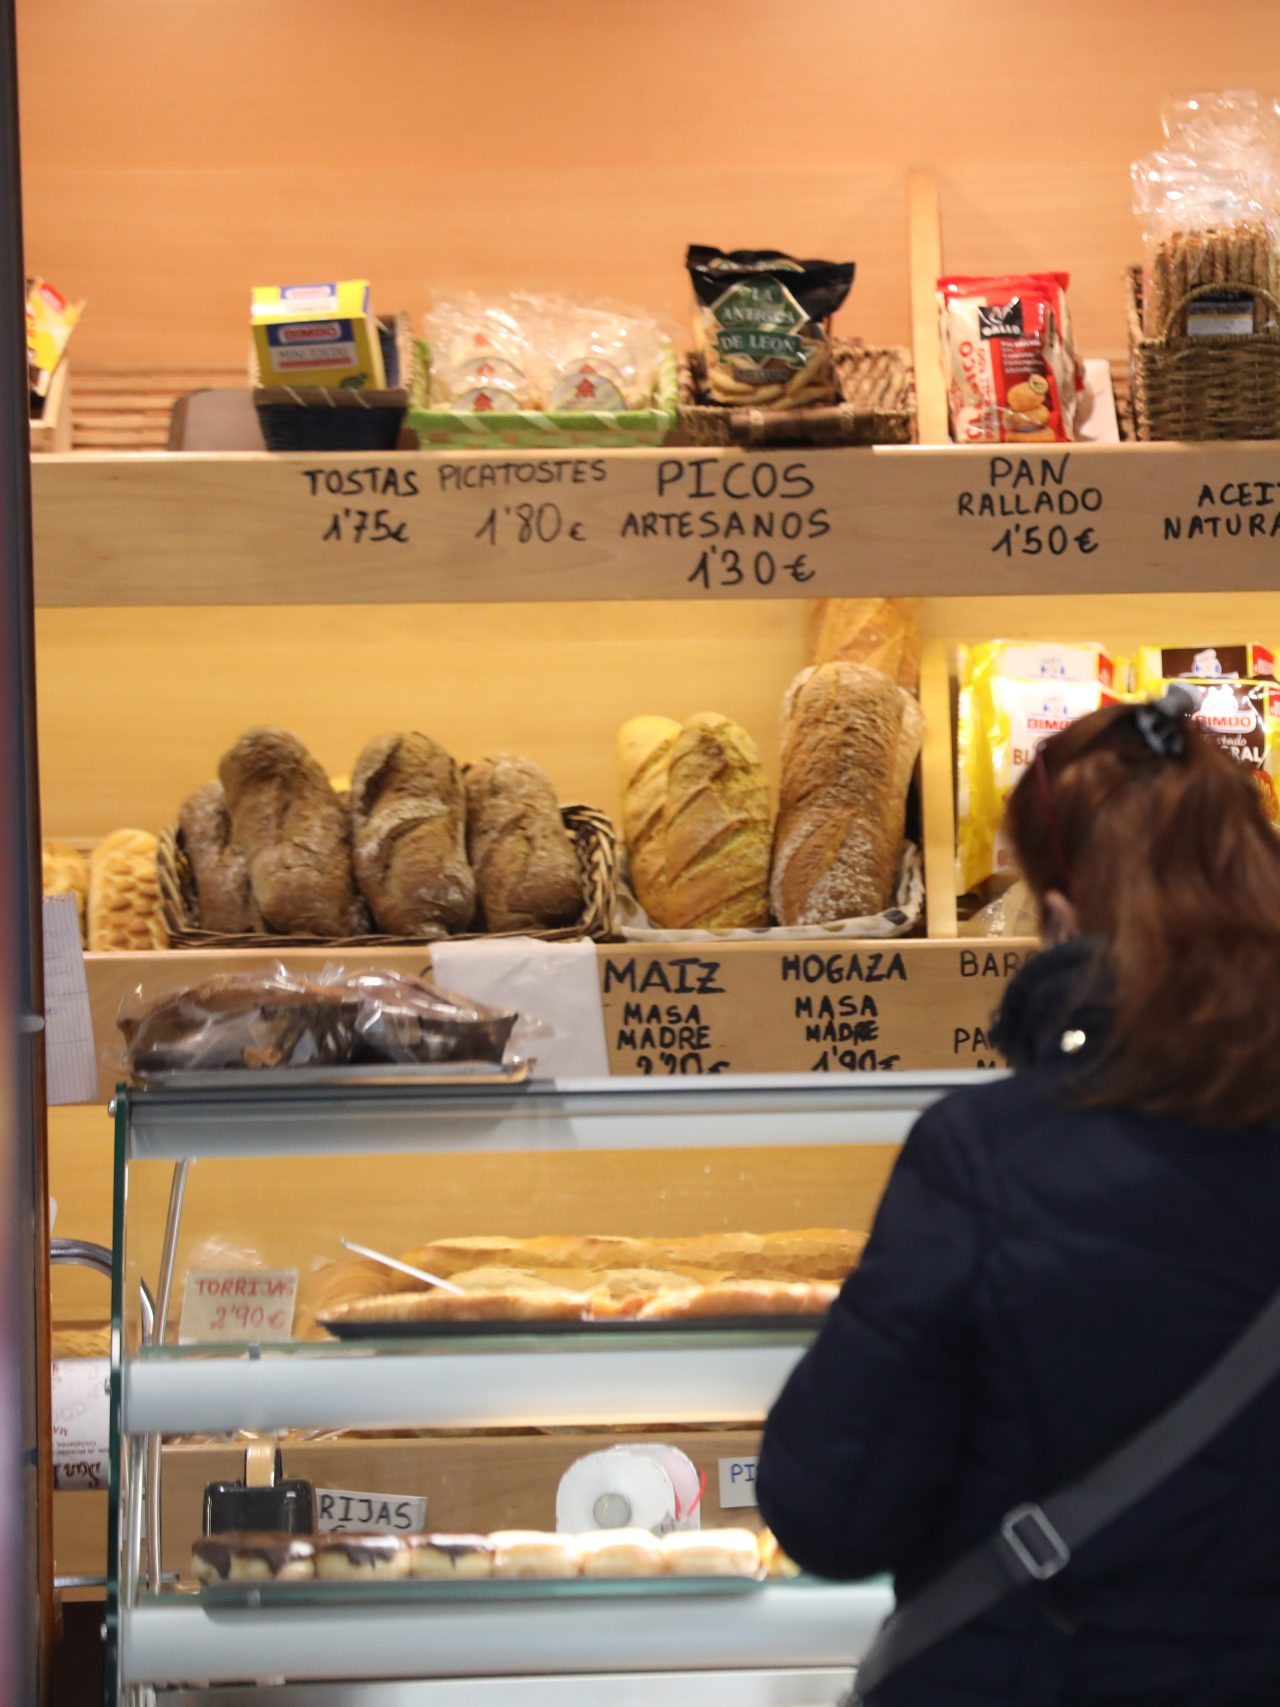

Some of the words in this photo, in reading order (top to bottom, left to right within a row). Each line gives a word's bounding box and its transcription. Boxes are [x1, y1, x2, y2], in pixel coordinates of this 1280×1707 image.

[719, 334, 745, 350] DE
[303, 467, 419, 496] TOSTAS
[438, 459, 607, 490] PICATOSTES
[658, 458, 815, 499] PICOS
[990, 452, 1070, 488] PAN
[958, 488, 1103, 516] RALLADO
[621, 509, 831, 539] ARTESANOS
[604, 957, 726, 994] MAIZ
[782, 952, 907, 984] HOGAZA
[623, 1002, 701, 1026] MASA
[795, 994, 878, 1019] MASA
[617, 1025, 711, 1050] MADRE
[805, 1020, 880, 1046] MADRE
